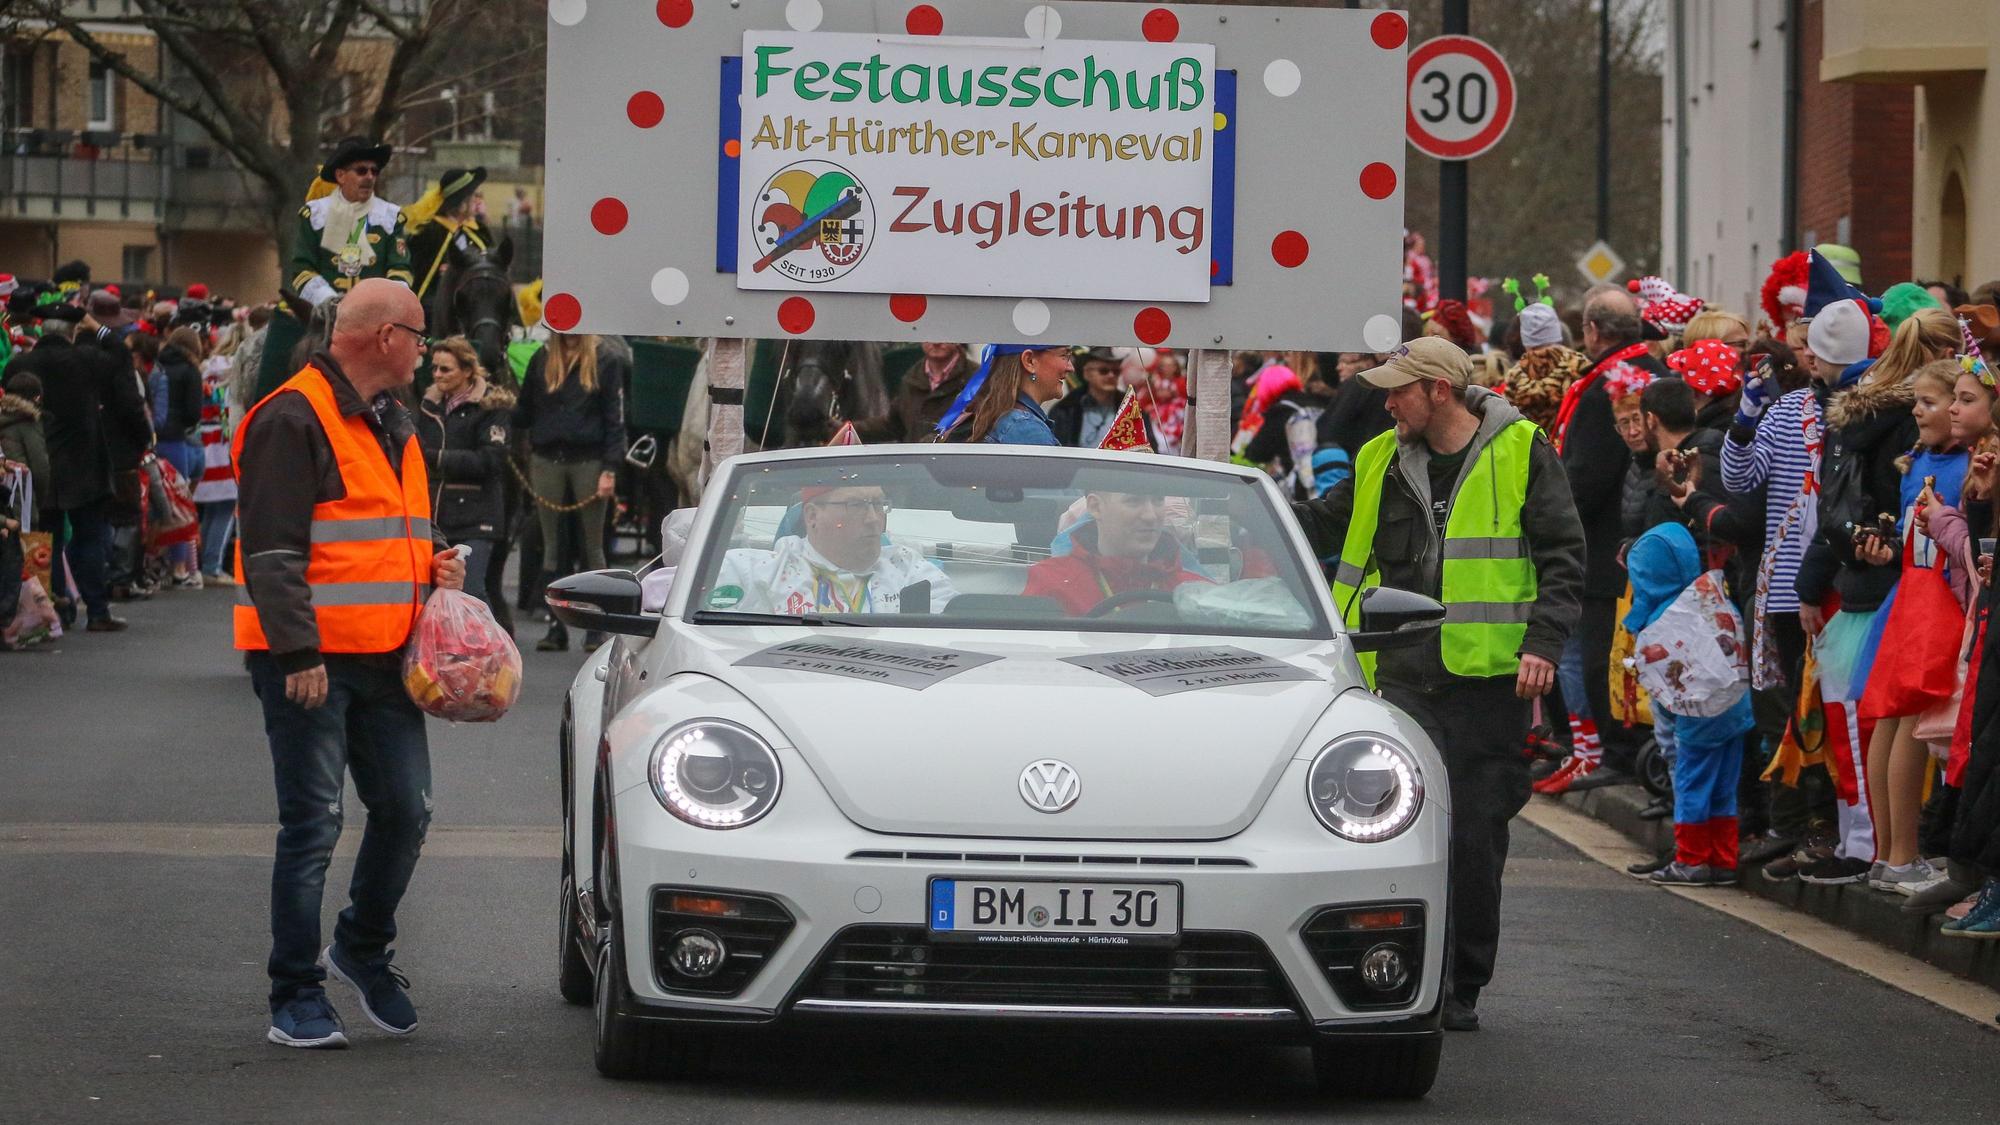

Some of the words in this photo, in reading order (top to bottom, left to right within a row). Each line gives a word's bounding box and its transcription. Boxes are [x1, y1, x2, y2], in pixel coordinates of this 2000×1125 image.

[754, 46, 1205, 111] Festausschuß
[1420, 70, 1487, 124] 30
[751, 114, 1202, 162] Alt-Hürther-Karneval
[889, 185, 1204, 255] Zugleitung
[780, 260, 806, 277] SEIT
[809, 266, 835, 279] 1930
[778, 642, 960, 671] Klinkhammer
[781, 658, 795, 666] 2
[811, 662, 831, 670] in
[834, 664, 890, 680] Hürth
[1177, 678, 1193, 687] 2
[1020, 760, 1079, 811] VW
[939, 910, 948, 921] D
[972, 887, 1025, 925] BM
[1053, 889, 1097, 926] II
[1109, 889, 1158, 927] 30
[978, 935, 1080, 944] www.bautz-klinkhammer.de
[1088, 936, 1129, 944] Hürth/Köln
